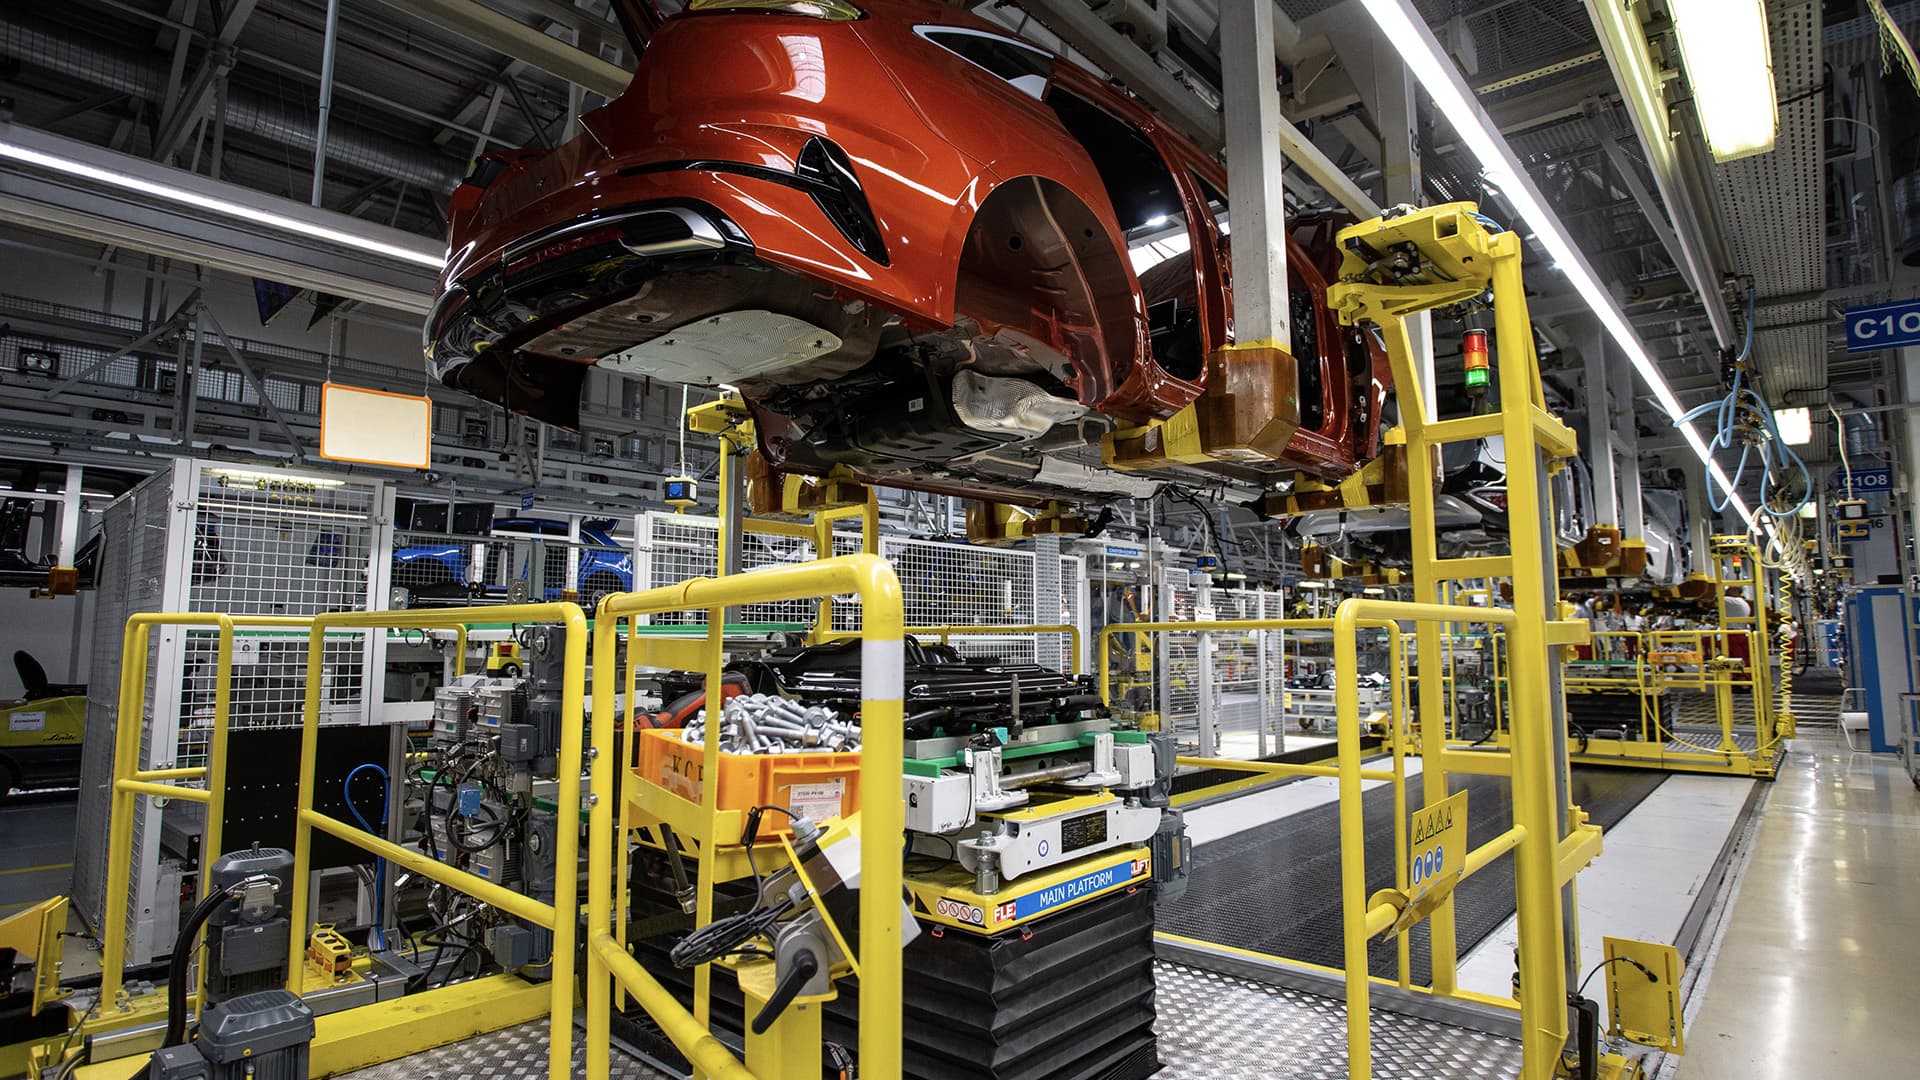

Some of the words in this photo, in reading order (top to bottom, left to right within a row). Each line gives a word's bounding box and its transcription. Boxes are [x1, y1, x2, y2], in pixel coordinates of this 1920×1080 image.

[1842, 474, 1888, 487] C108
[1040, 888, 1065, 907] MAIN
[1067, 871, 1113, 898] PLATFORM
